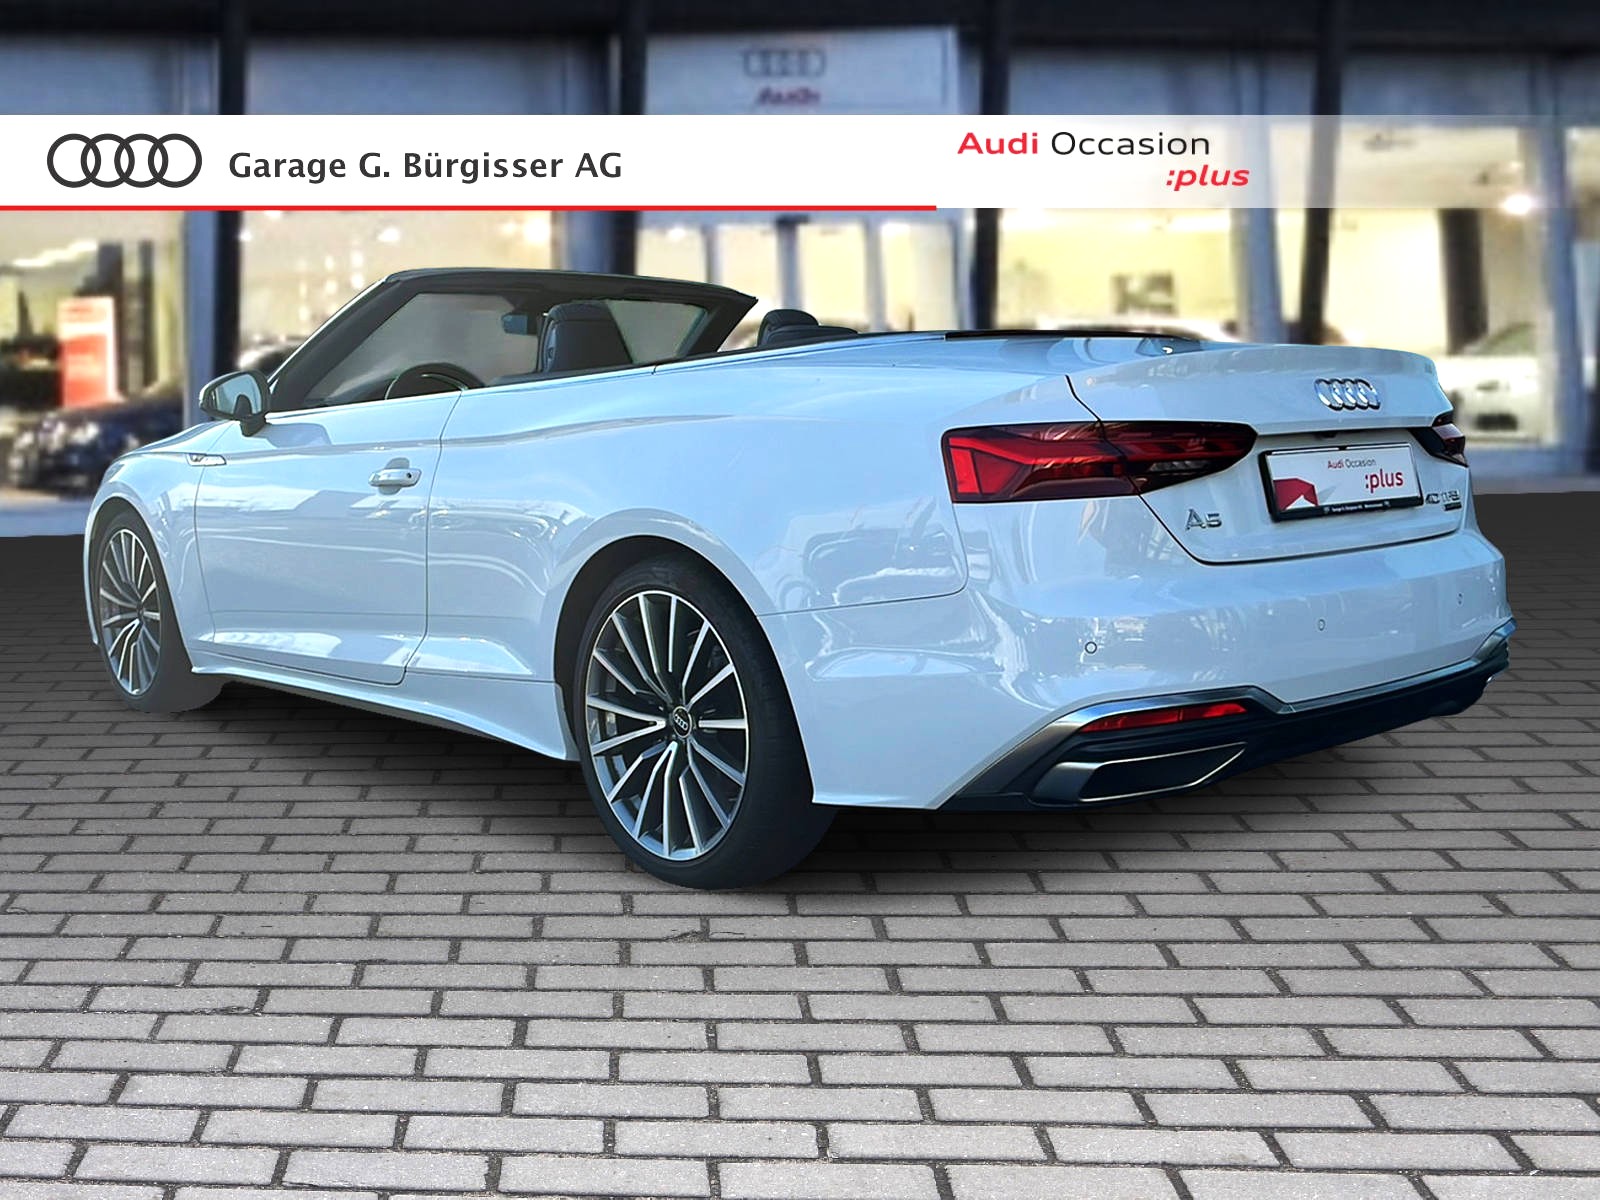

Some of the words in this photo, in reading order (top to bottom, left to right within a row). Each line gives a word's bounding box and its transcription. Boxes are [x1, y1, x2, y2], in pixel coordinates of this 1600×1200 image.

[1327, 460, 1344, 469] Audi
[1345, 458, 1376, 469] Occasion
[1365, 468, 1404, 493] :plus
[1185, 508, 1222, 531] A5
